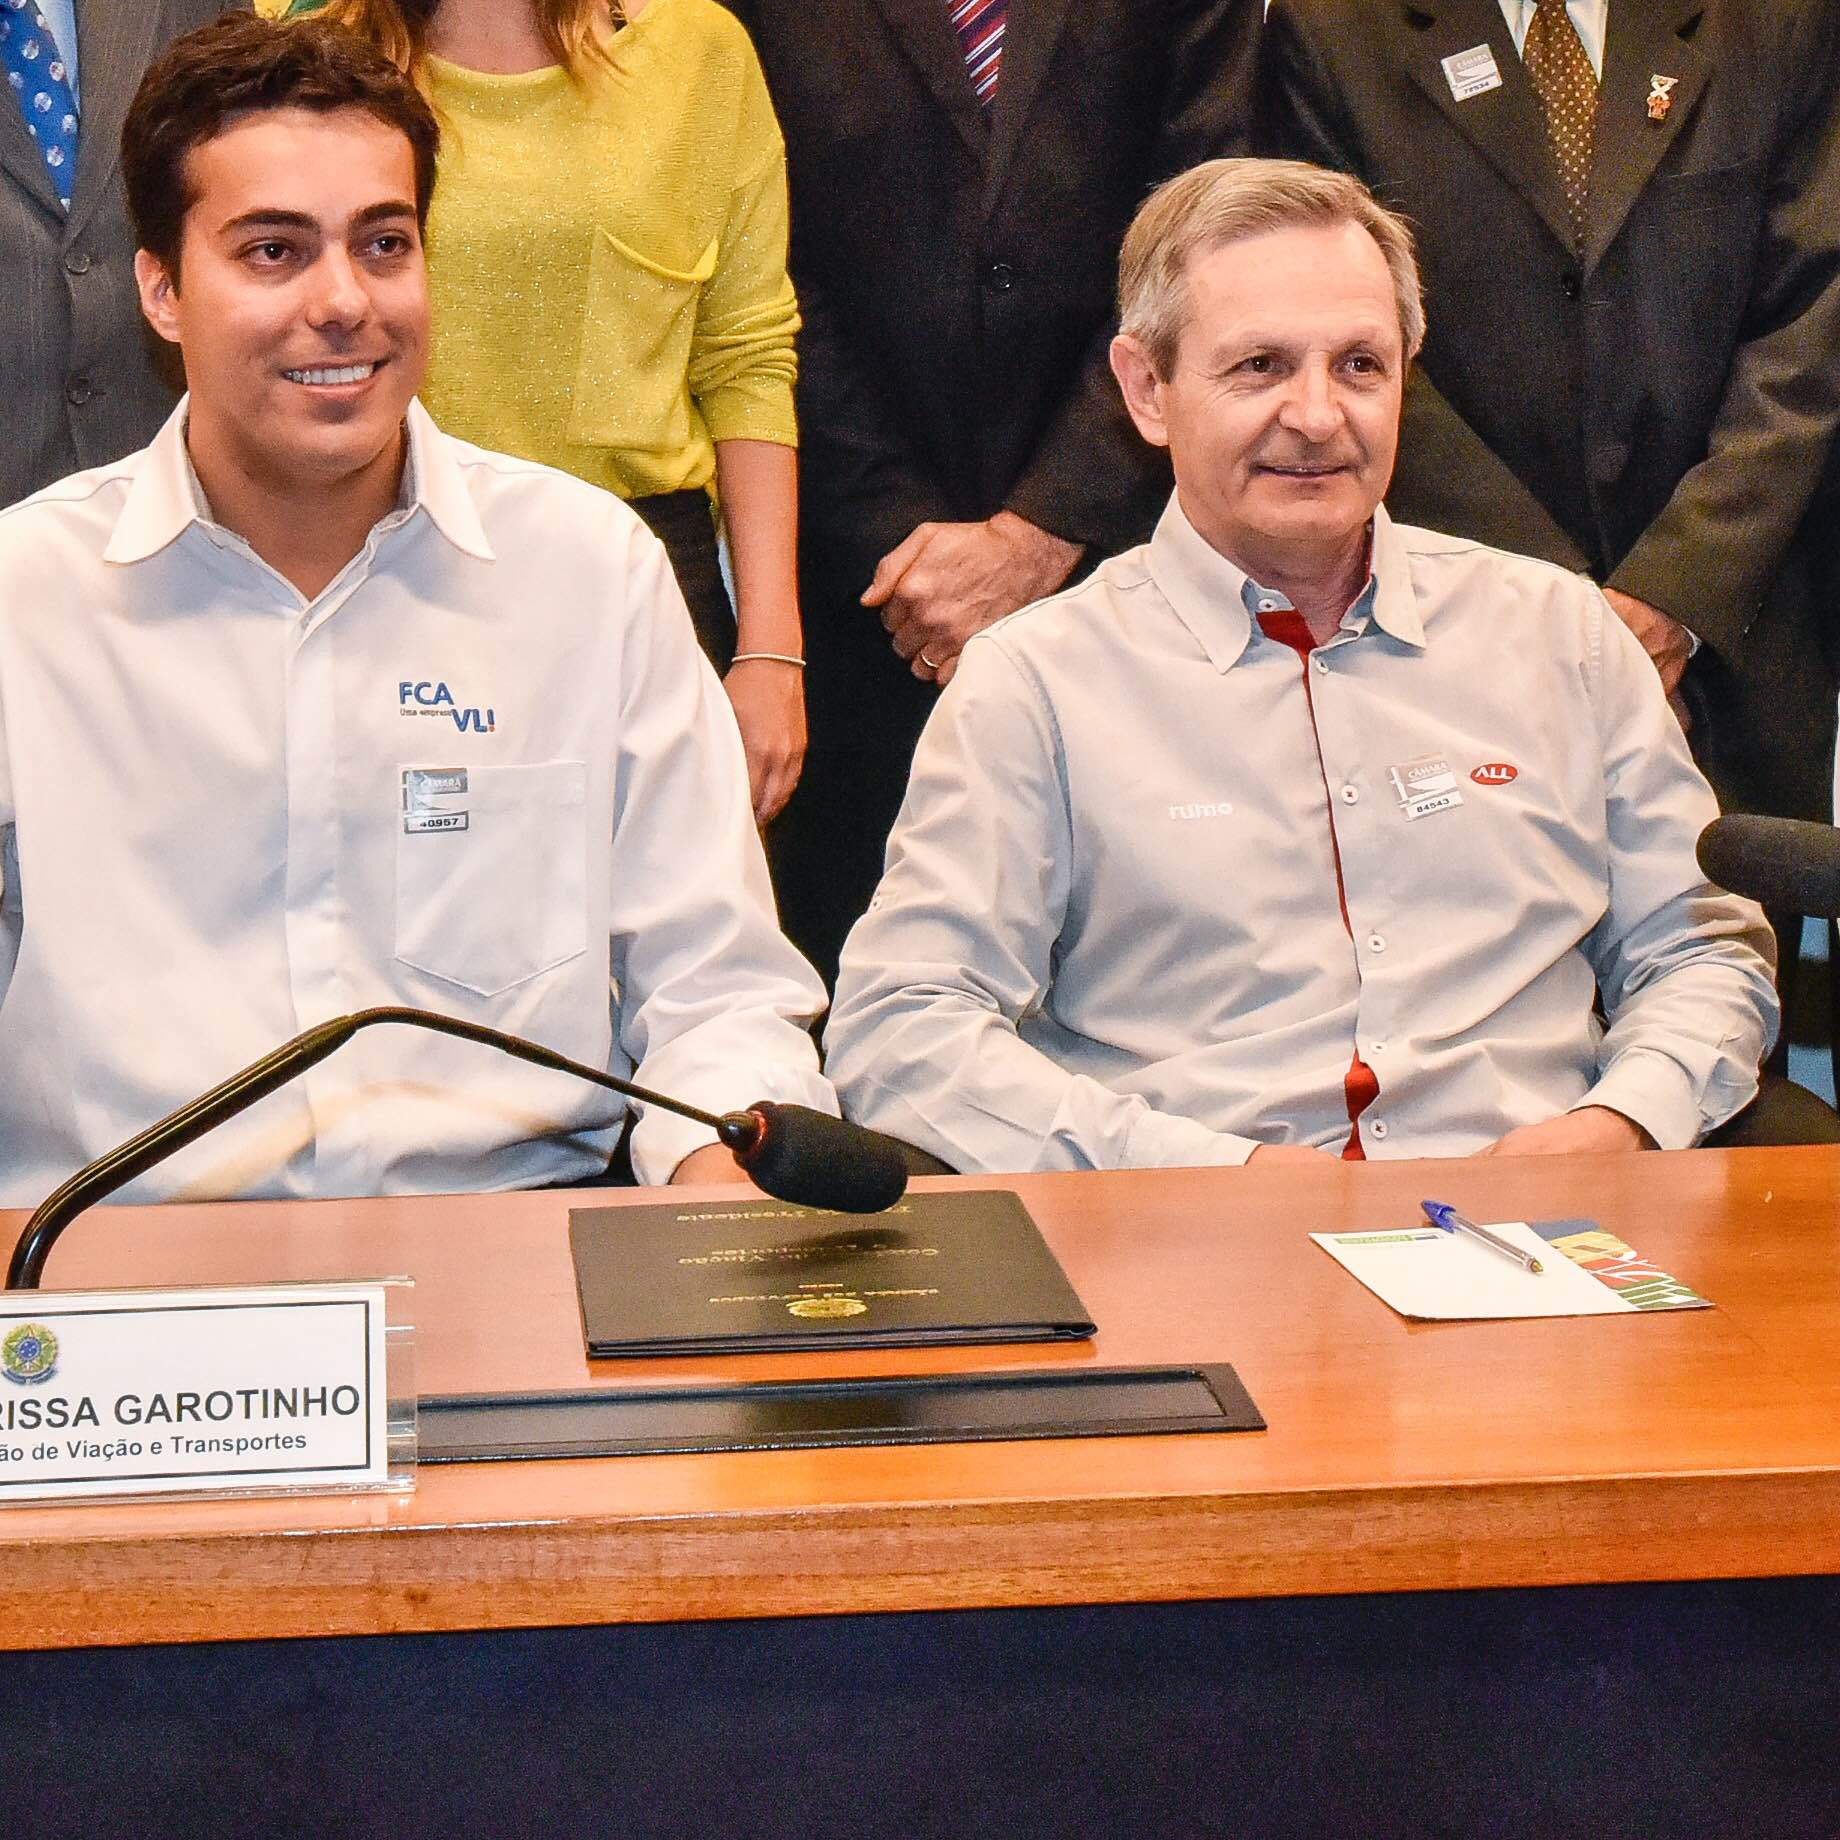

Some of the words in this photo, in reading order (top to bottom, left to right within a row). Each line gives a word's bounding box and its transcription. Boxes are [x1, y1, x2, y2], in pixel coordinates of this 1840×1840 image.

[399, 682, 454, 705] FCA
[1475, 766, 1513, 780] ALL
[1168, 803, 1233, 820] rumo
[113, 1385, 360, 1425] GAROTINHO
[31, 1443, 58, 1460] de
[67, 1439, 142, 1462] Viação
[150, 1441, 162, 1455] e
[170, 1433, 307, 1458] Transportes
